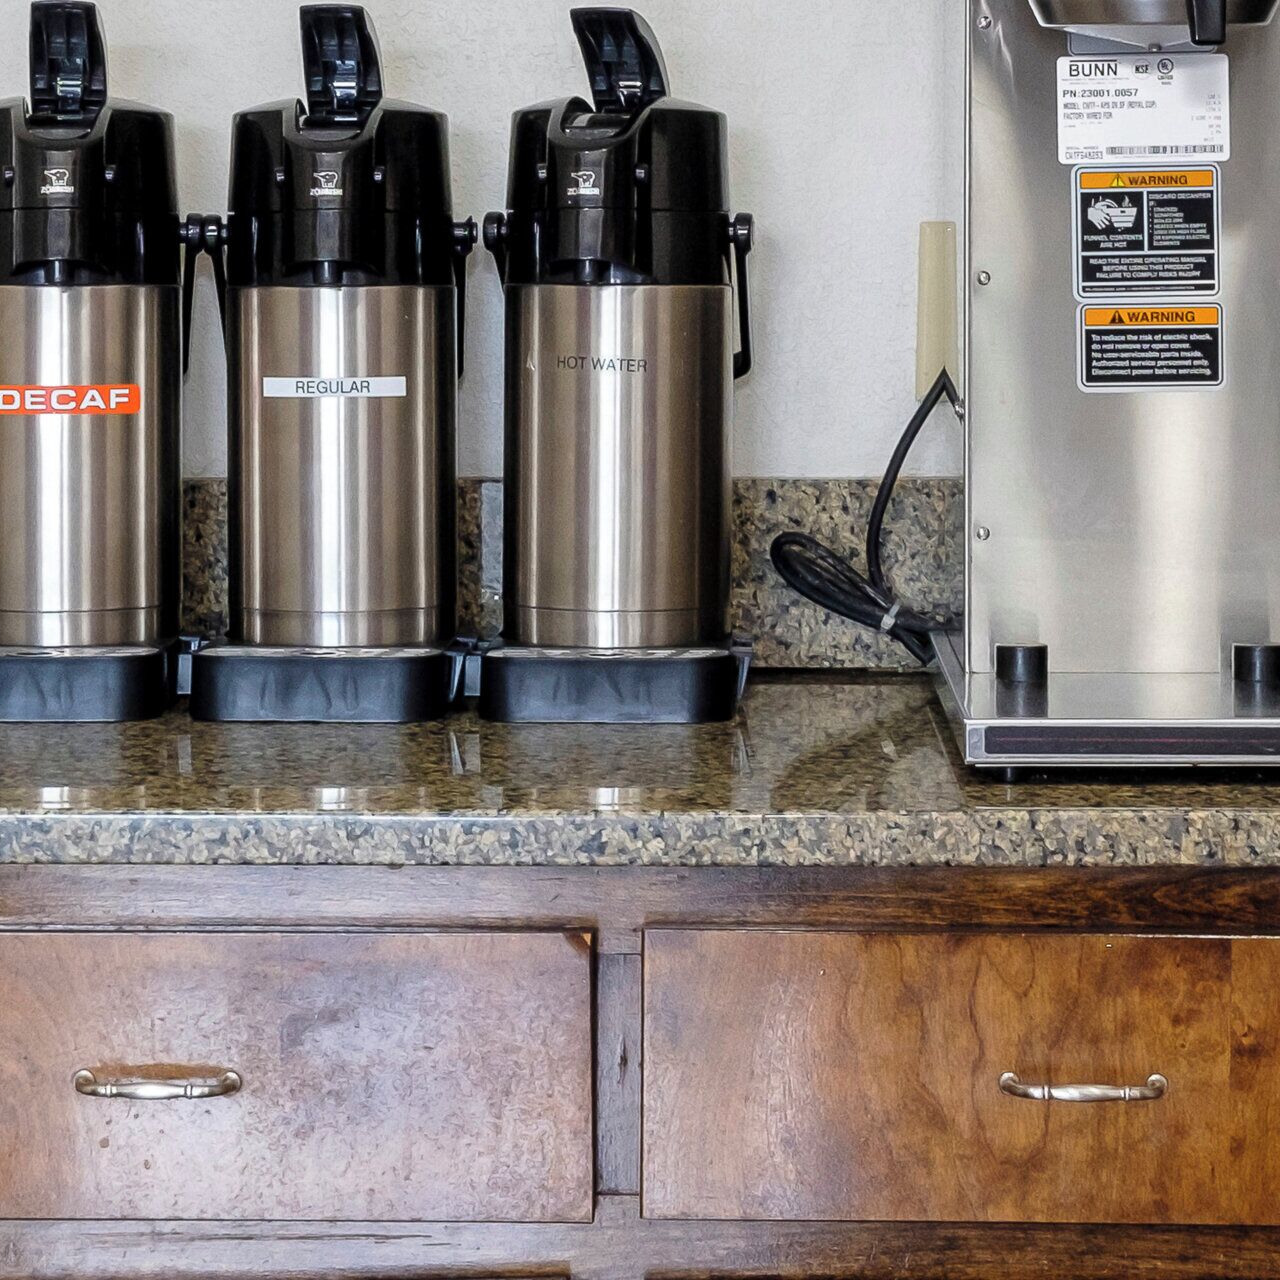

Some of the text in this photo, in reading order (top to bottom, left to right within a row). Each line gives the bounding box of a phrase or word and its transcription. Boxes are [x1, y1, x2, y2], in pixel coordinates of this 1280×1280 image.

[1070, 62, 1118, 77] BUNN
[1128, 175, 1188, 185] WARNING
[1128, 311, 1195, 322] WARNING
[557, 356, 648, 372] HOT WATER
[296, 381, 370, 393] REGULAR
